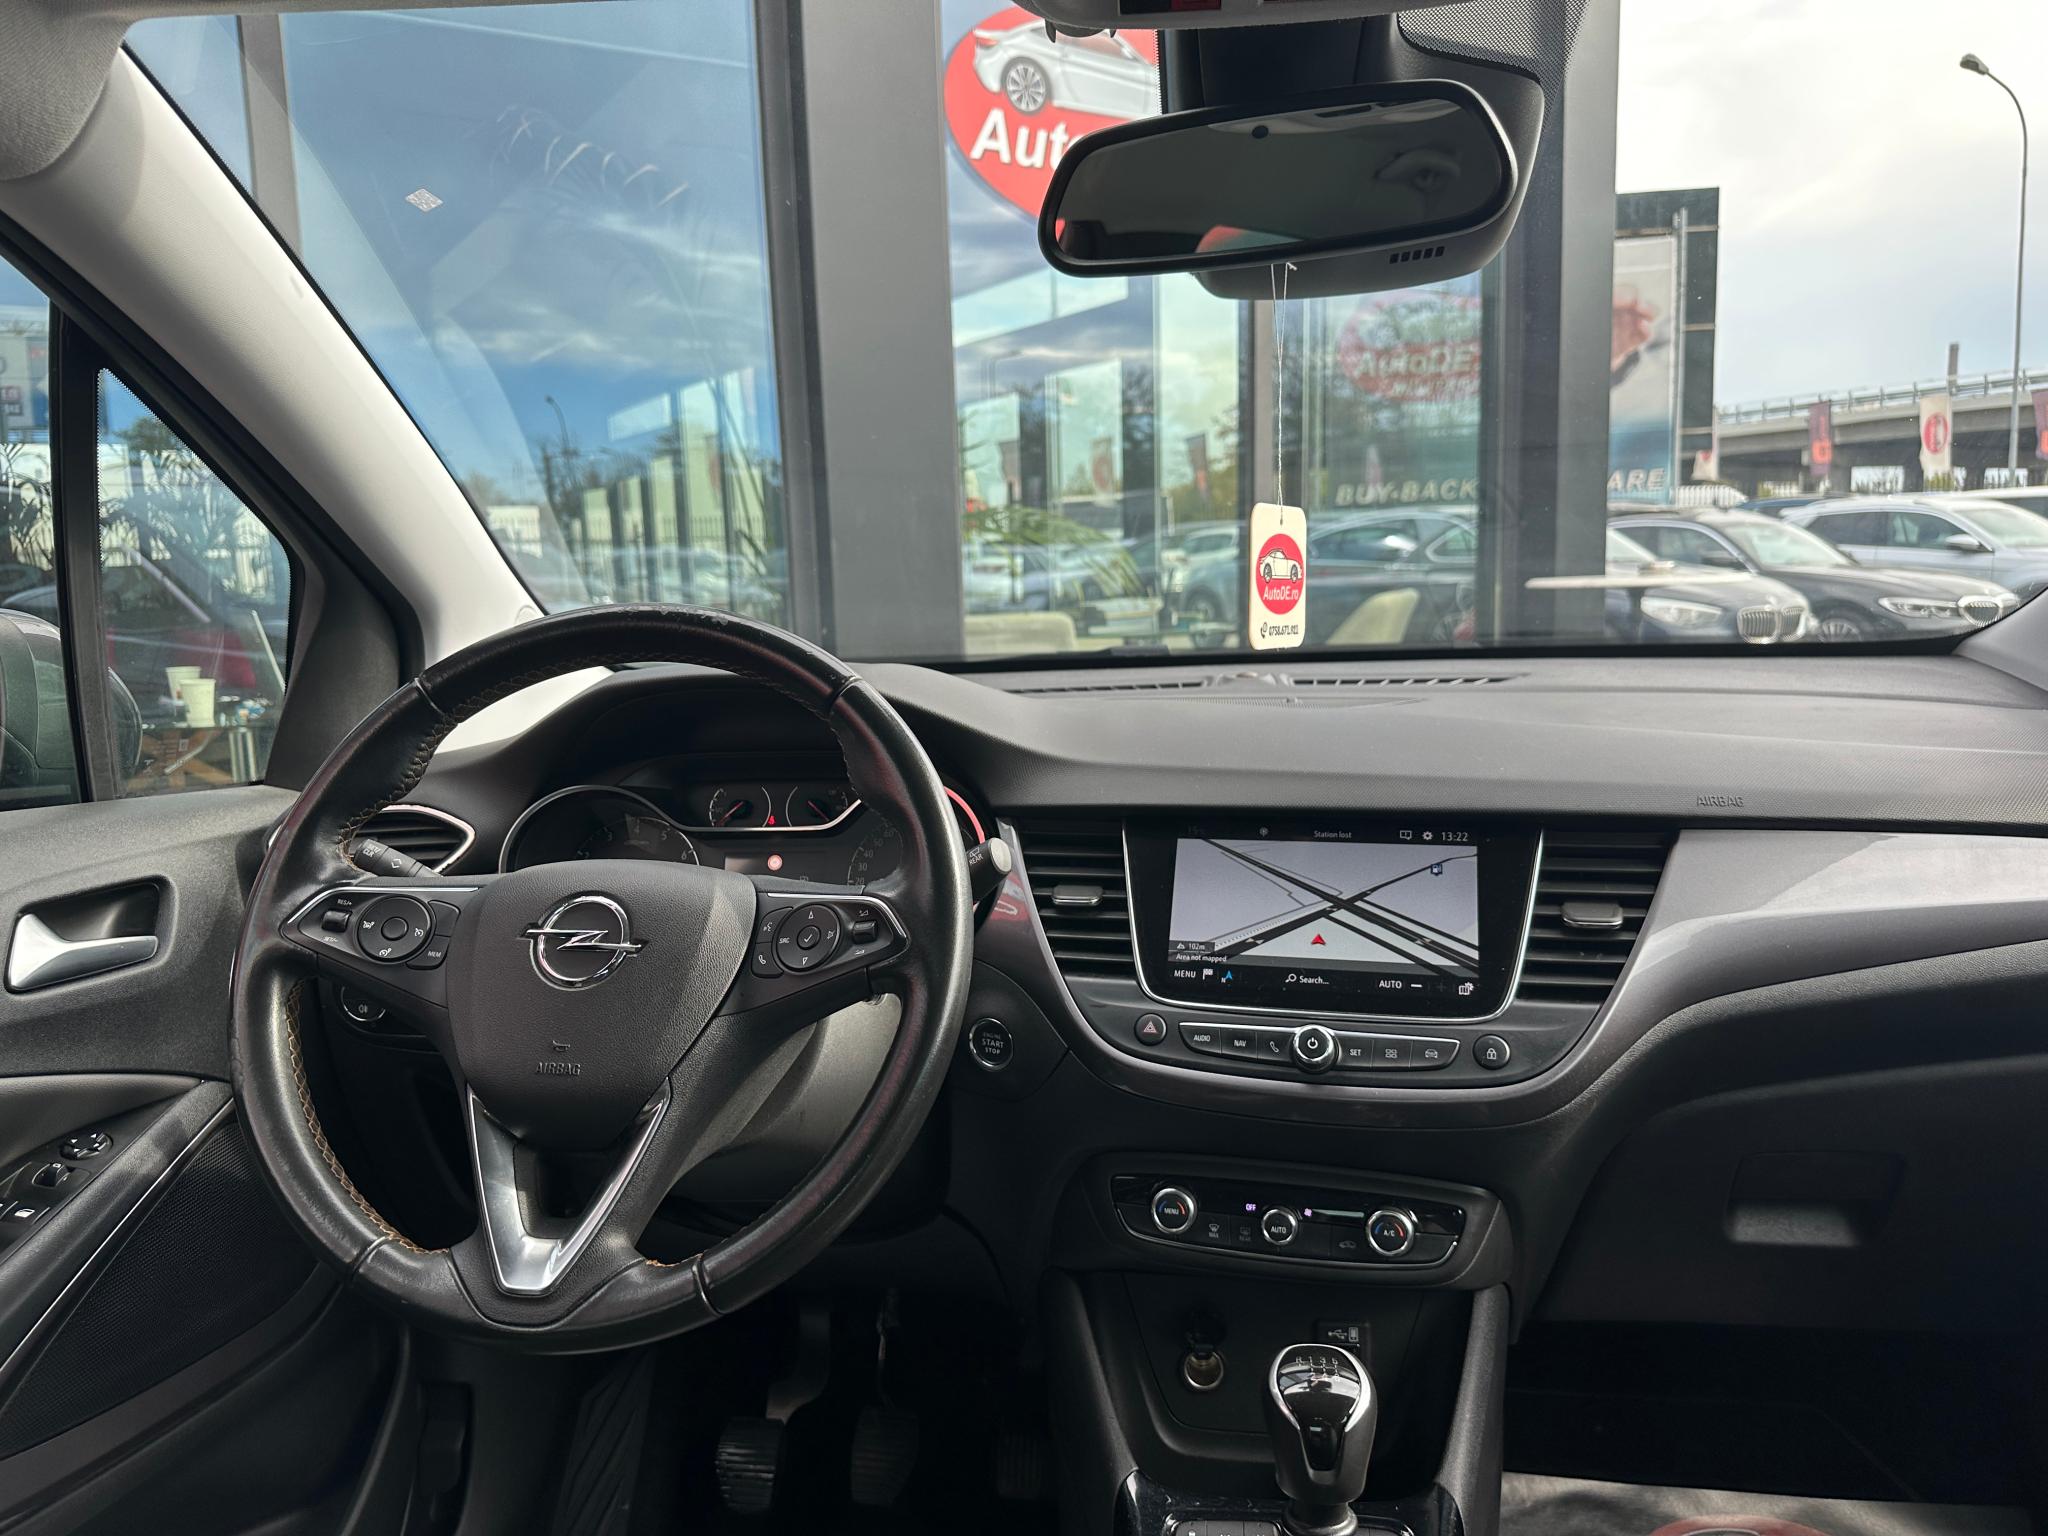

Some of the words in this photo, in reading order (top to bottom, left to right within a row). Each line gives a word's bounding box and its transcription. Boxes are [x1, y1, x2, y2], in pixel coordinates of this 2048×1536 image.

[970, 107, 1080, 170] Aut
[1263, 586, 1299, 600] AutoDE.ro
[1696, 795, 1744, 807] AIRBAG
[1314, 830, 1338, 838] Station
[1338, 830, 1352, 839] lost
[1441, 831, 1468, 842] 13:22
[969, 853, 983, 865] REAR
[1202, 955, 1227, 963] mapped
[1173, 970, 1196, 978] MENU
[1299, 975, 1329, 985] Search...
[1379, 980, 1402, 989] AUTO
[1193, 1034, 1211, 1042] AUDIO
[982, 1038, 1004, 1048] START
[985, 1047, 1001, 1055] STOP
[536, 1061, 581, 1075] AIRBAG
[1164, 1207, 1179, 1215] MENU
[1270, 1226, 1287, 1234] AUTO
